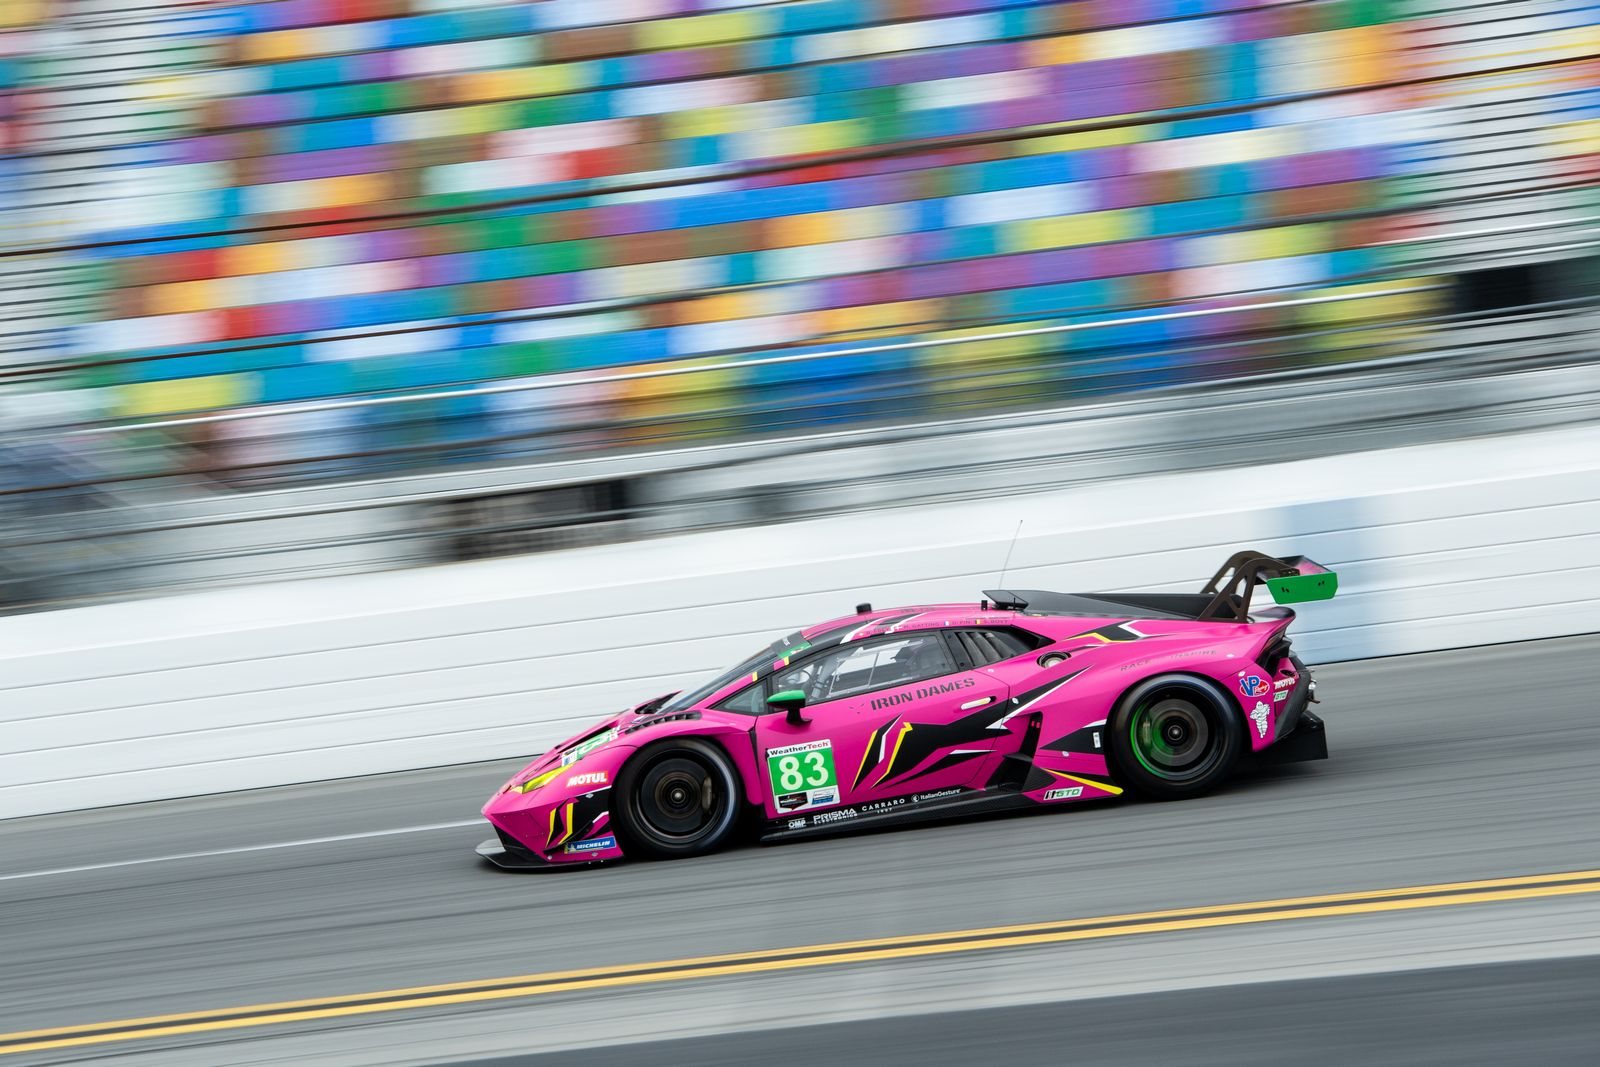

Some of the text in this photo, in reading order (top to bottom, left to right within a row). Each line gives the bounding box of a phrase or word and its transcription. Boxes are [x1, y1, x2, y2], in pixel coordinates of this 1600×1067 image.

[1239, 675, 1261, 697] VP
[870, 678, 975, 710] IRON DAMES
[770, 741, 829, 756] WeatherTech
[778, 751, 829, 791] 83
[567, 772, 607, 787] MOTUL
[861, 798, 905, 812] CARRARO
[813, 808, 857, 822] PRISMA
[788, 819, 806, 829] OMP
[576, 840, 611, 849] MICHELIN
